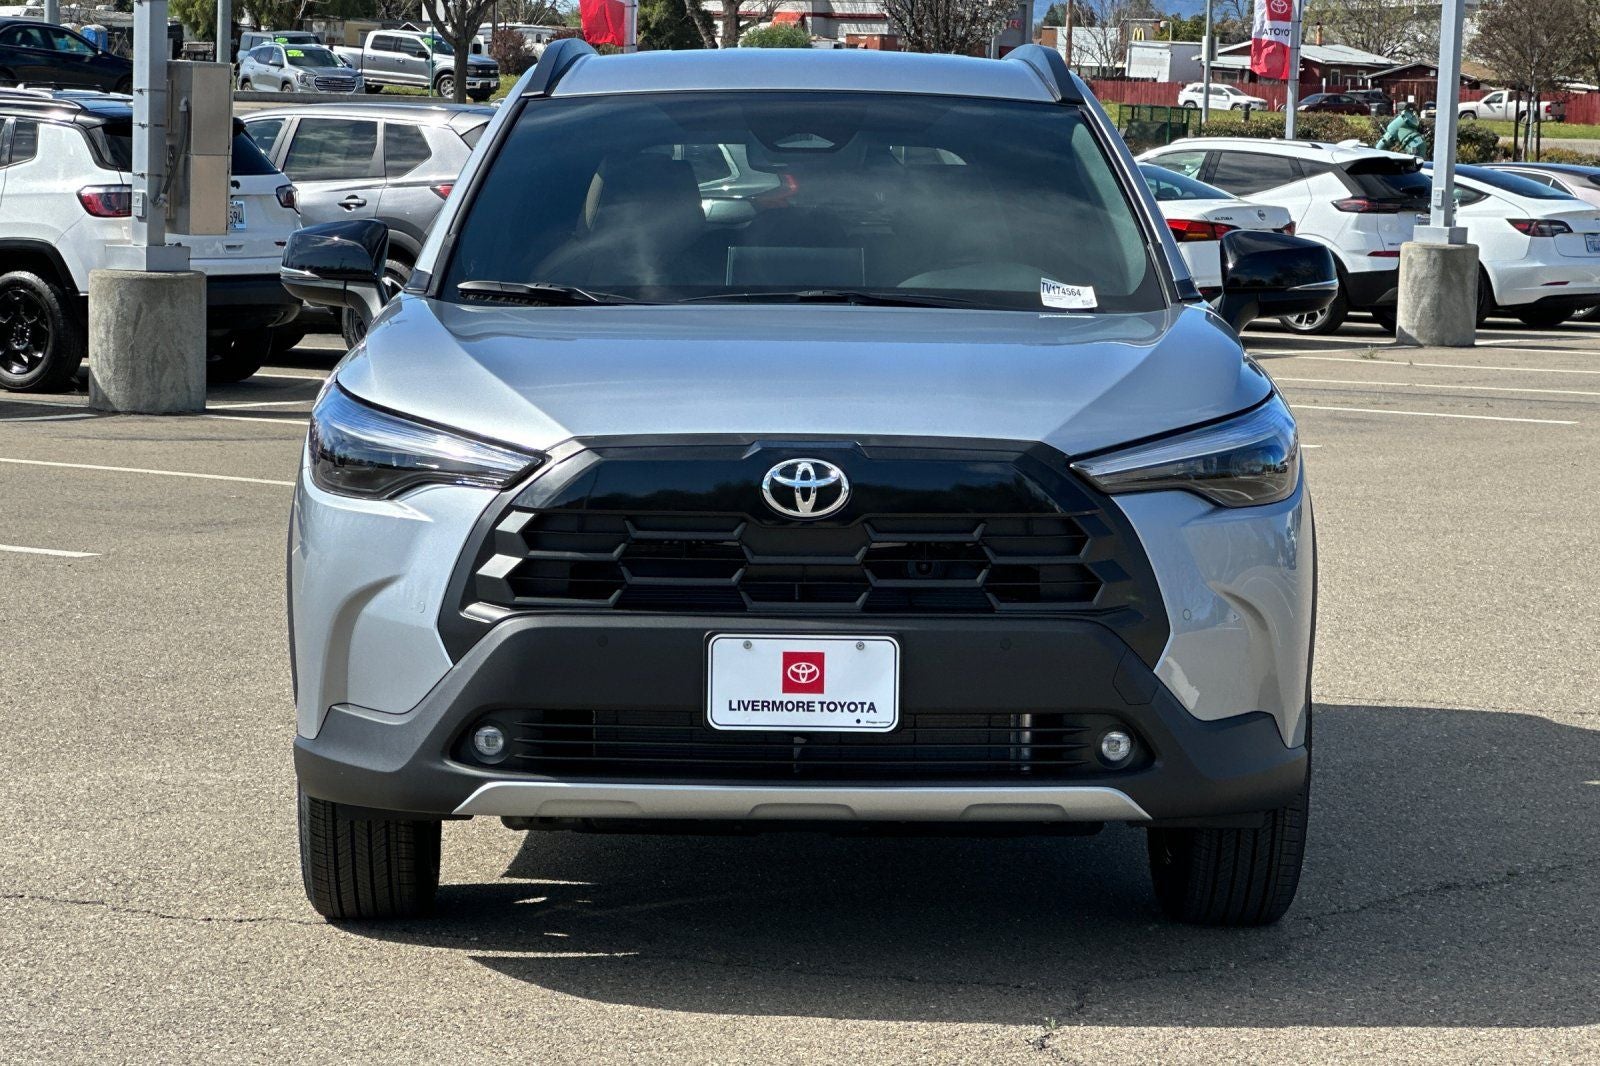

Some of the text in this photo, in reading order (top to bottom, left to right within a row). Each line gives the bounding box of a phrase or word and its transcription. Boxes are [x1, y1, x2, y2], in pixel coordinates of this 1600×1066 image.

[1041, 281, 1082, 297] TV174564
[728, 699, 878, 714] LIVERMORE TOYOTA
